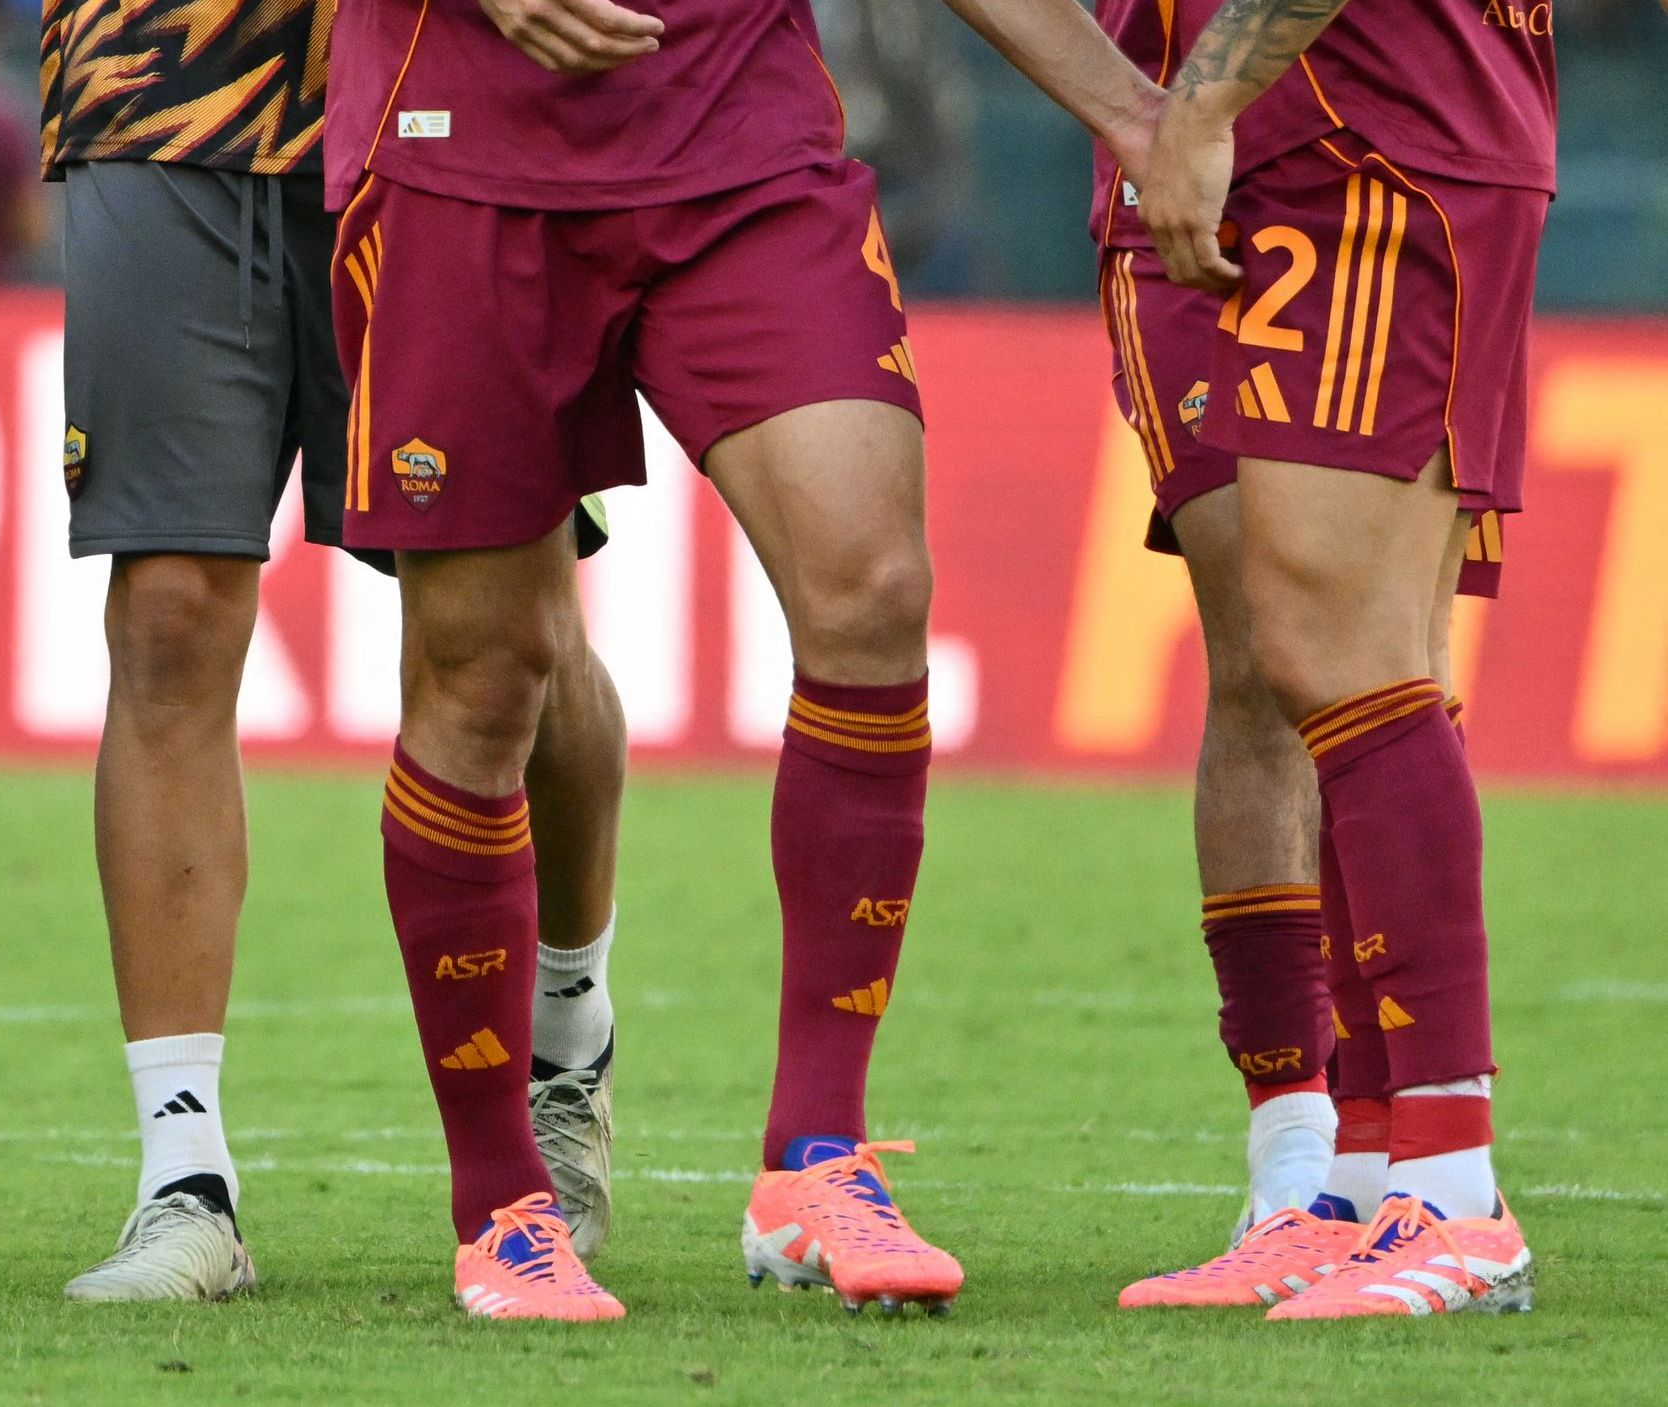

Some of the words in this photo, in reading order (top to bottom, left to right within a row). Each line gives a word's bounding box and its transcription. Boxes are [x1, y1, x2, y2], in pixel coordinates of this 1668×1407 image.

[401, 479, 442, 493] ROMA
[850, 896, 911, 927] ASR
[434, 948, 507, 981] ASR
[1239, 1046, 1303, 1076] ASR
